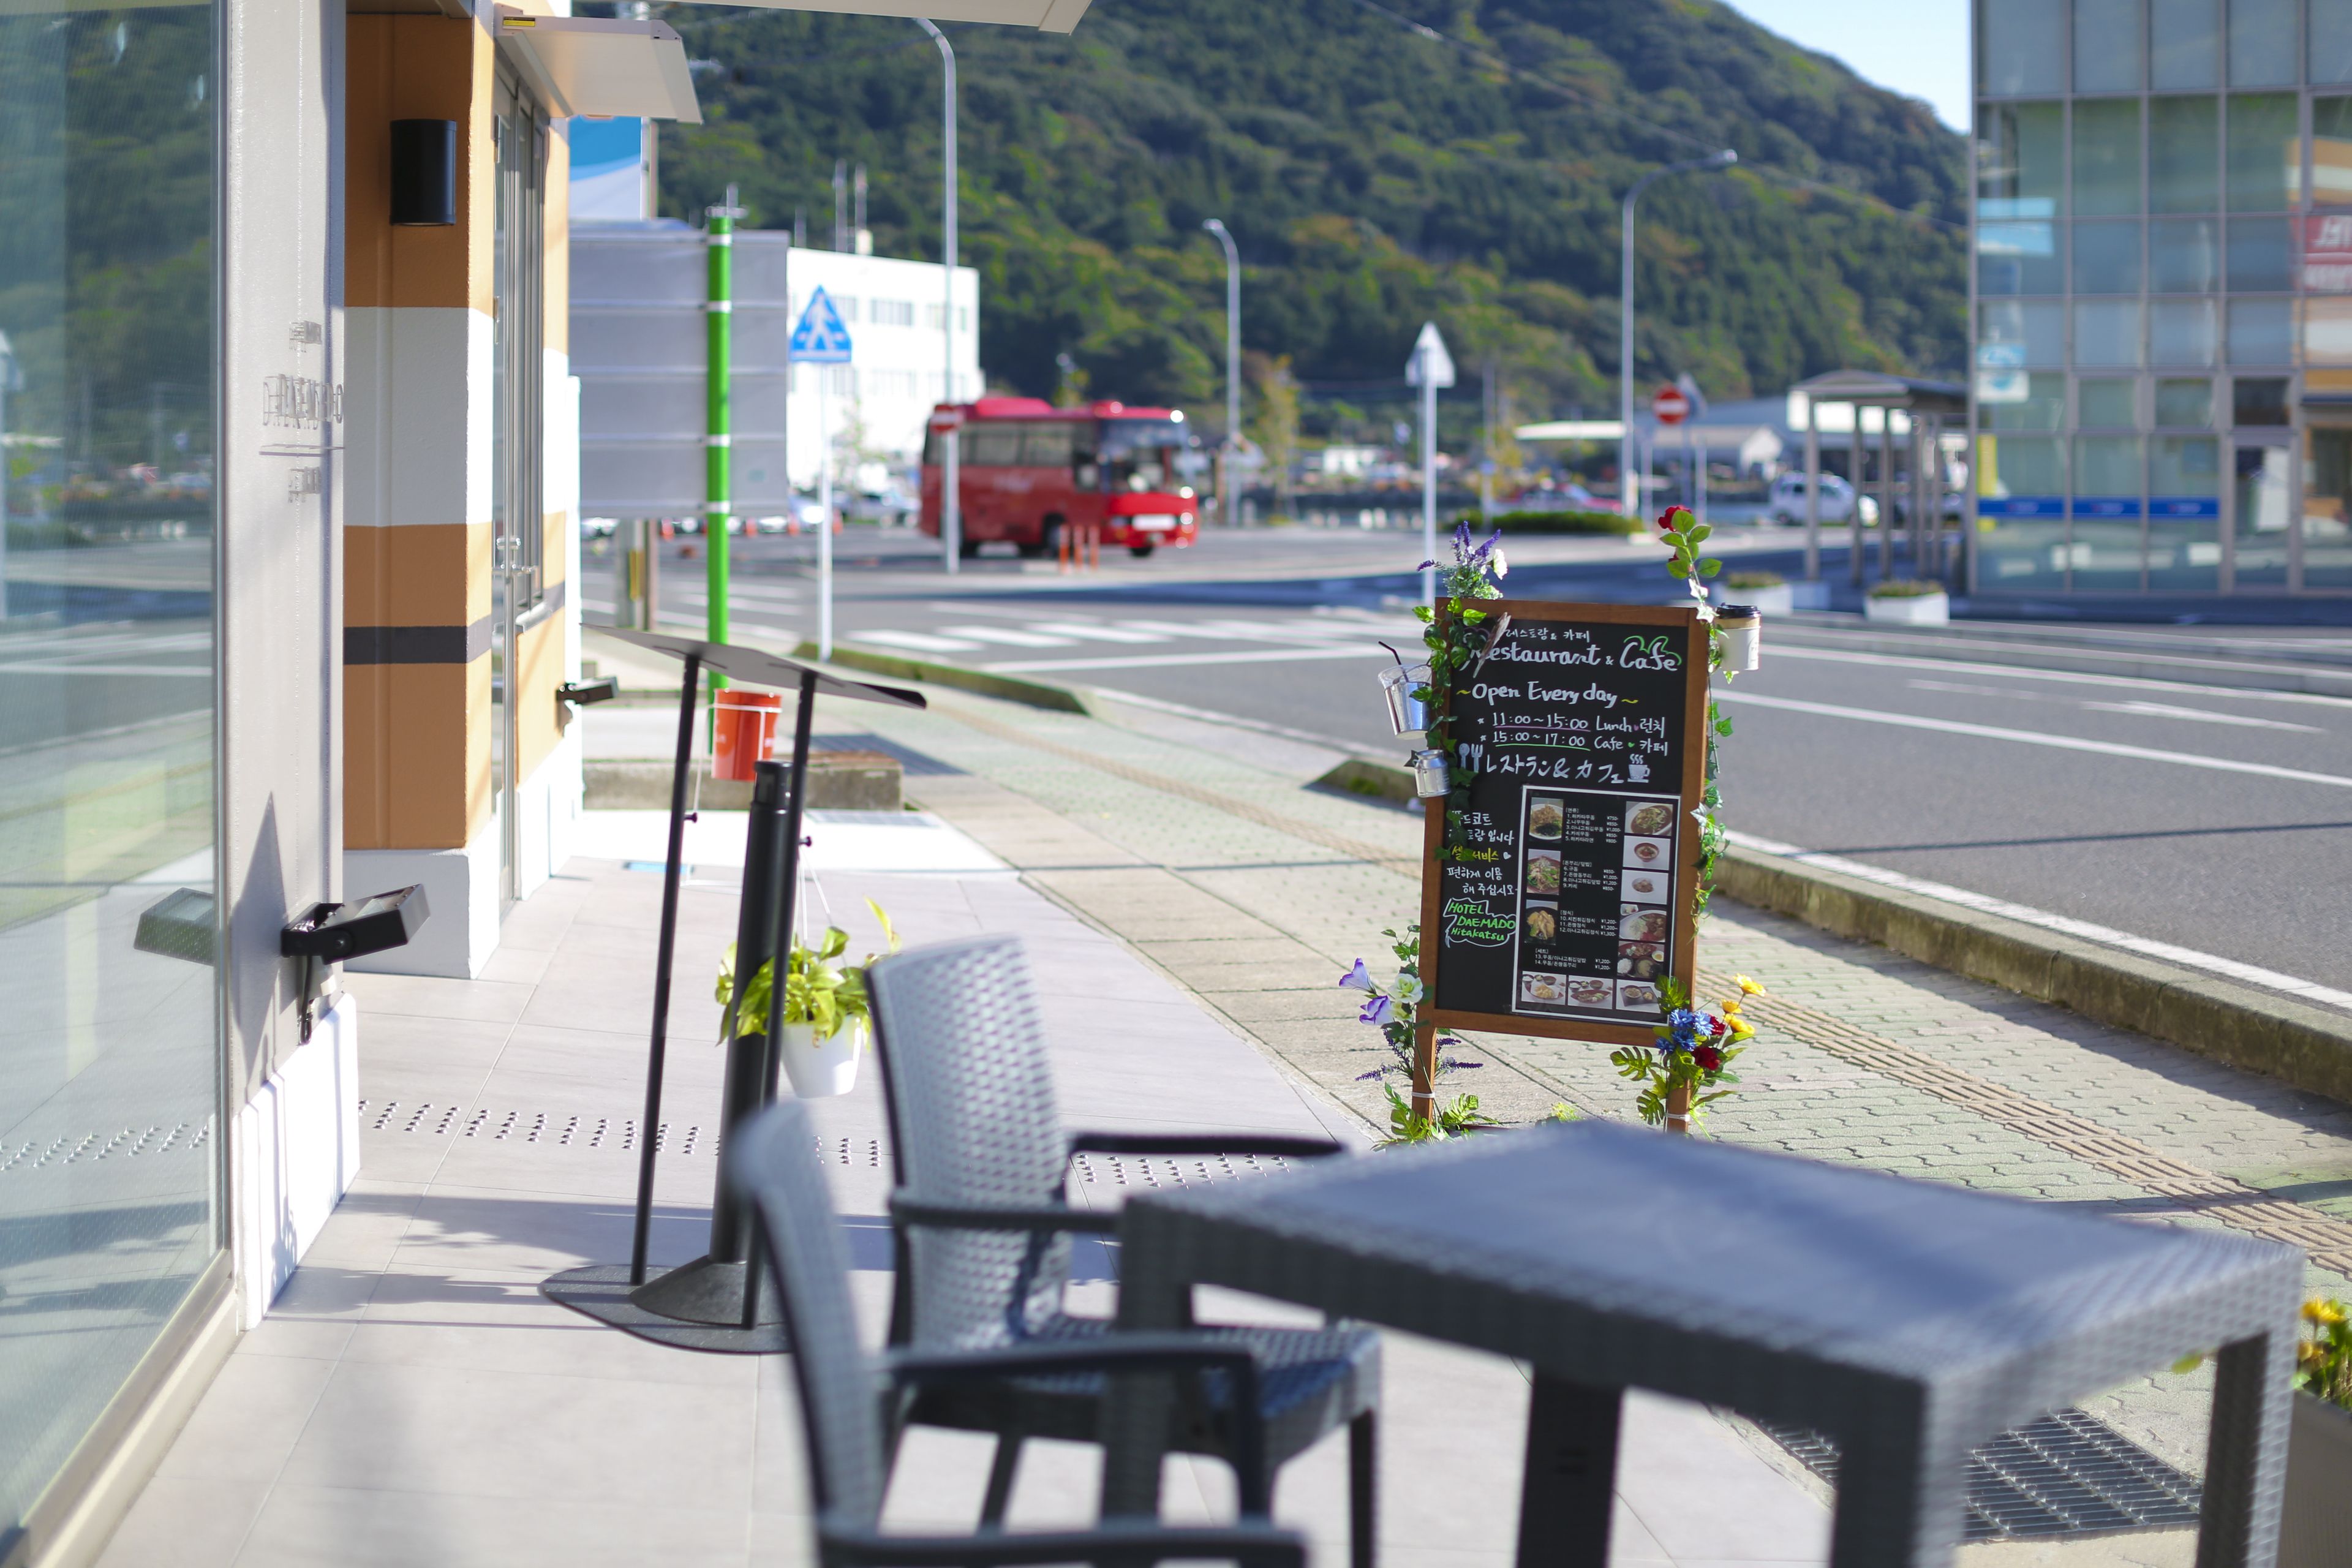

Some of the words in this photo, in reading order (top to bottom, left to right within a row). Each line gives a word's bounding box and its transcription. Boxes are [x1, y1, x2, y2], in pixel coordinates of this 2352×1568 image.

[1563, 629, 1590, 643] 카페
[1605, 655, 1614, 666] &
[1619, 642, 1678, 671] Cafe
[1472, 684, 1520, 706] Open
[1596, 715, 1632, 733] Lunch
[1640, 717, 1665, 739] 런치
[1594, 736, 1623, 751] Cafe
[1639, 738, 1668, 756] 카페
[1488, 829, 1514, 845] 입니다
[1447, 866, 1480, 878] 편하게
[1485, 867, 1502, 880] 이용
[1448, 902, 1484, 914] HOTEL
[1457, 916, 1516, 929] DAEMADO
[1451, 928, 1504, 941] Hitakatsu
